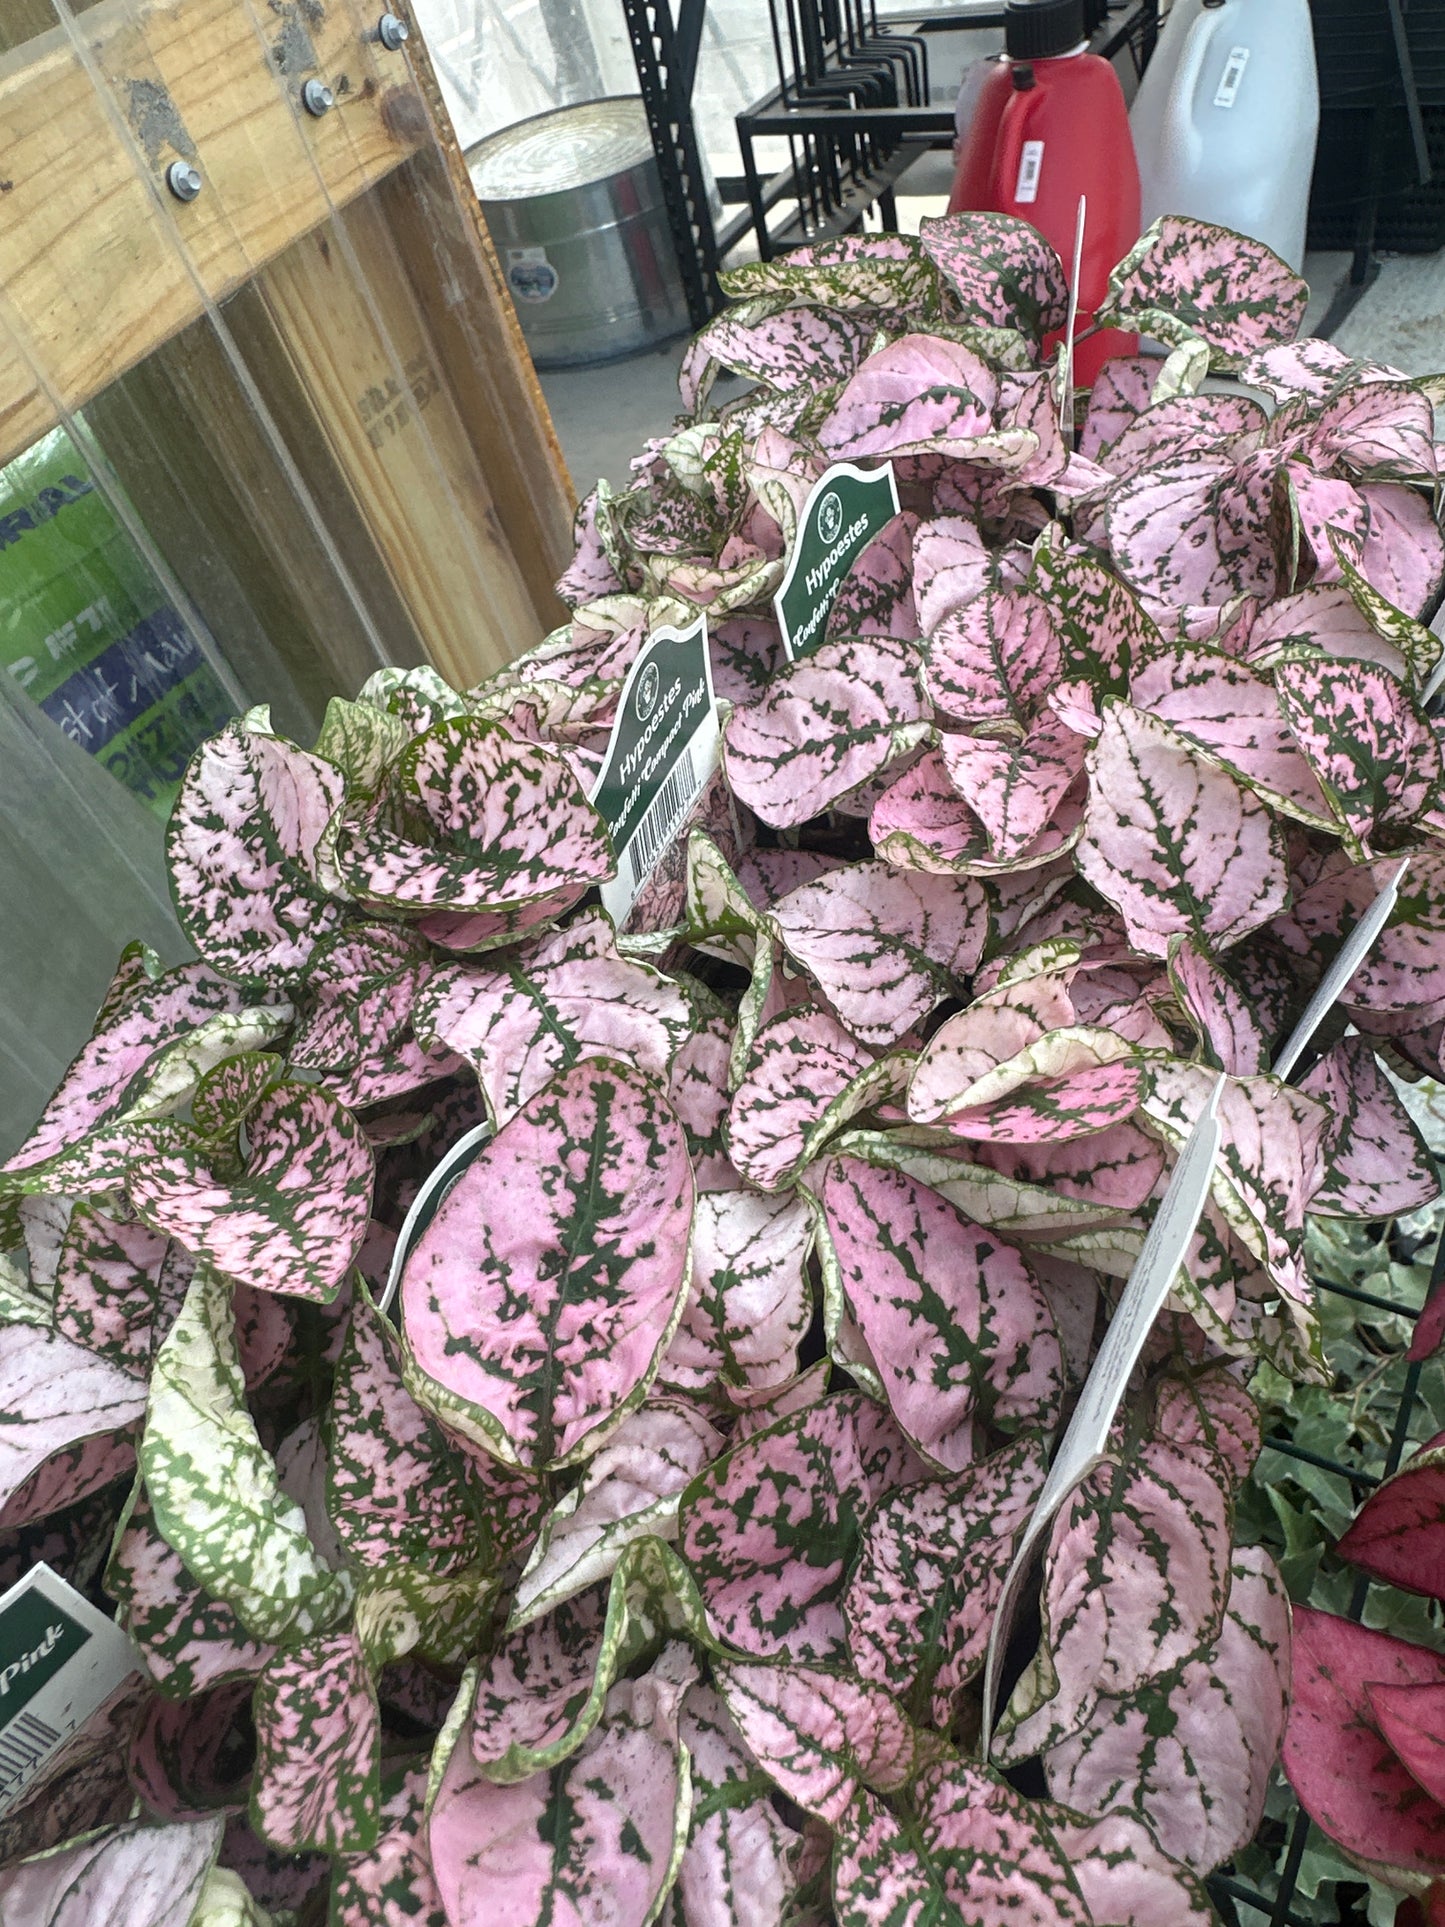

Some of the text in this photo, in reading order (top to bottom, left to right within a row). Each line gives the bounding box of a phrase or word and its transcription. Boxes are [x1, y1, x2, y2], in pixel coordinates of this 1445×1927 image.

[805, 512, 870, 596] Hypoestes
[792, 594, 830, 648] Confetti
[619, 676, 682, 786] Hypoestes
[640, 711, 683, 783] Compact
[682, 677, 705, 719] Pink
[0, 1622, 65, 1697] Pink
